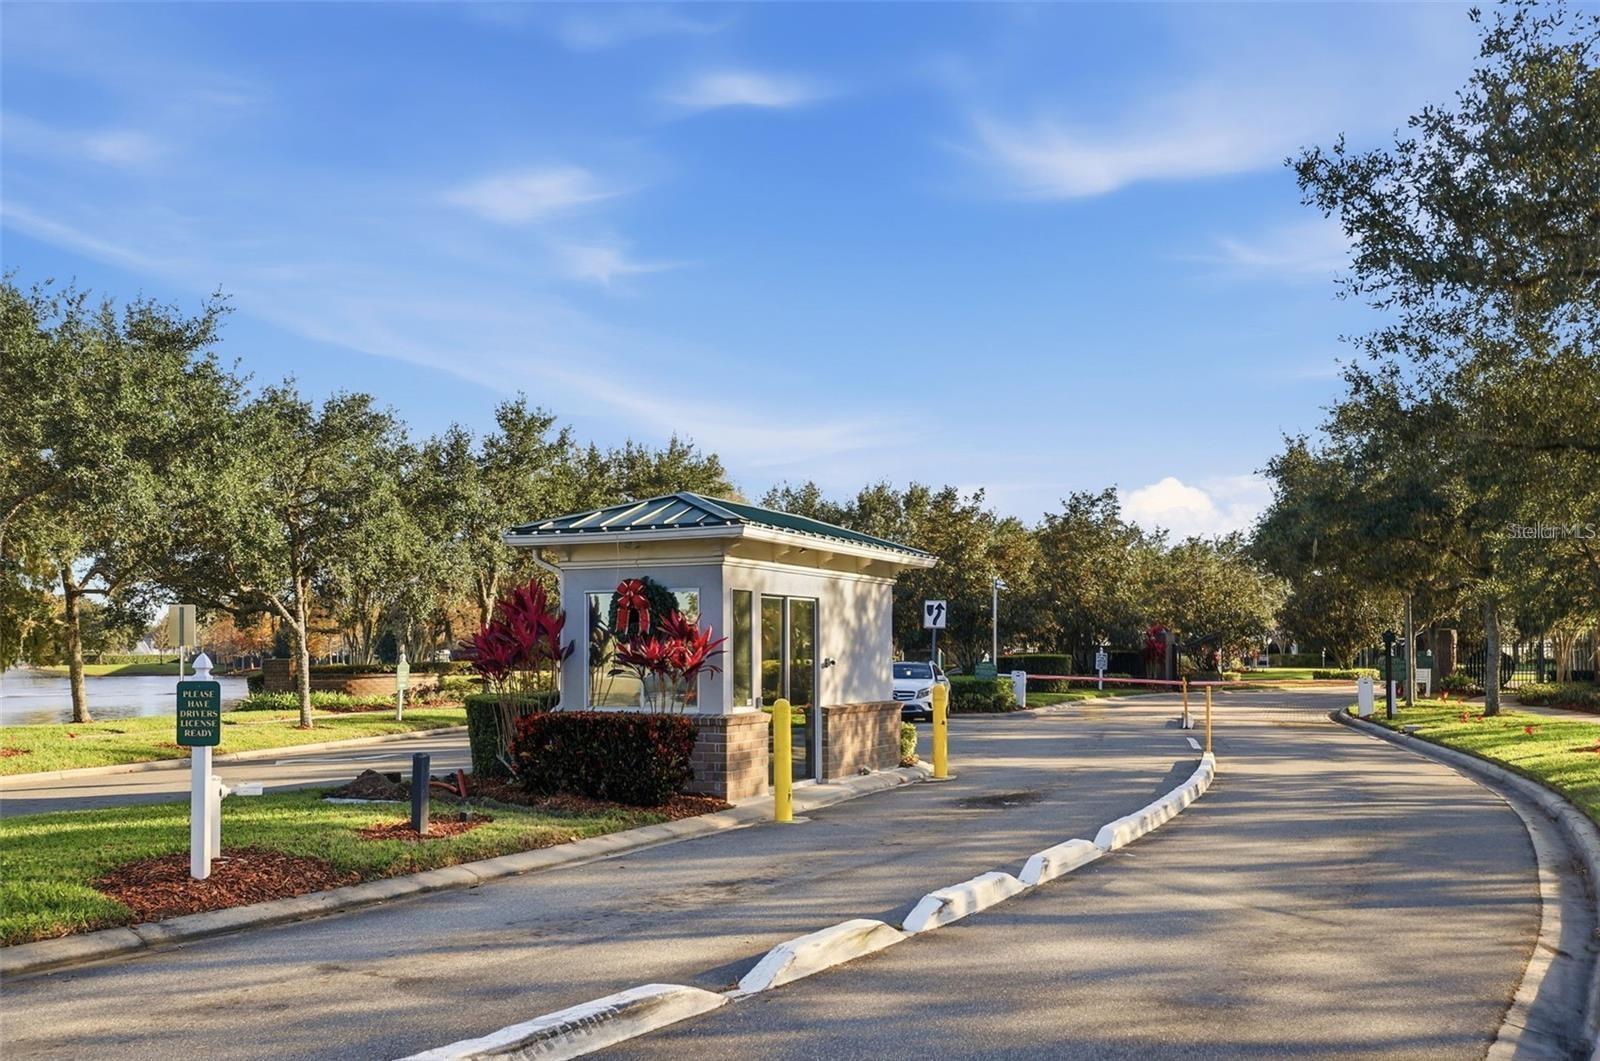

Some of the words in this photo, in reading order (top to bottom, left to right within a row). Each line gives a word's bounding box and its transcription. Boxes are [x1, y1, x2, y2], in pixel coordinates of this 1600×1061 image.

[182, 690, 215, 698] PLEASE
[187, 700, 209, 708] HAVE
[180, 710, 218, 718] DRIVERS
